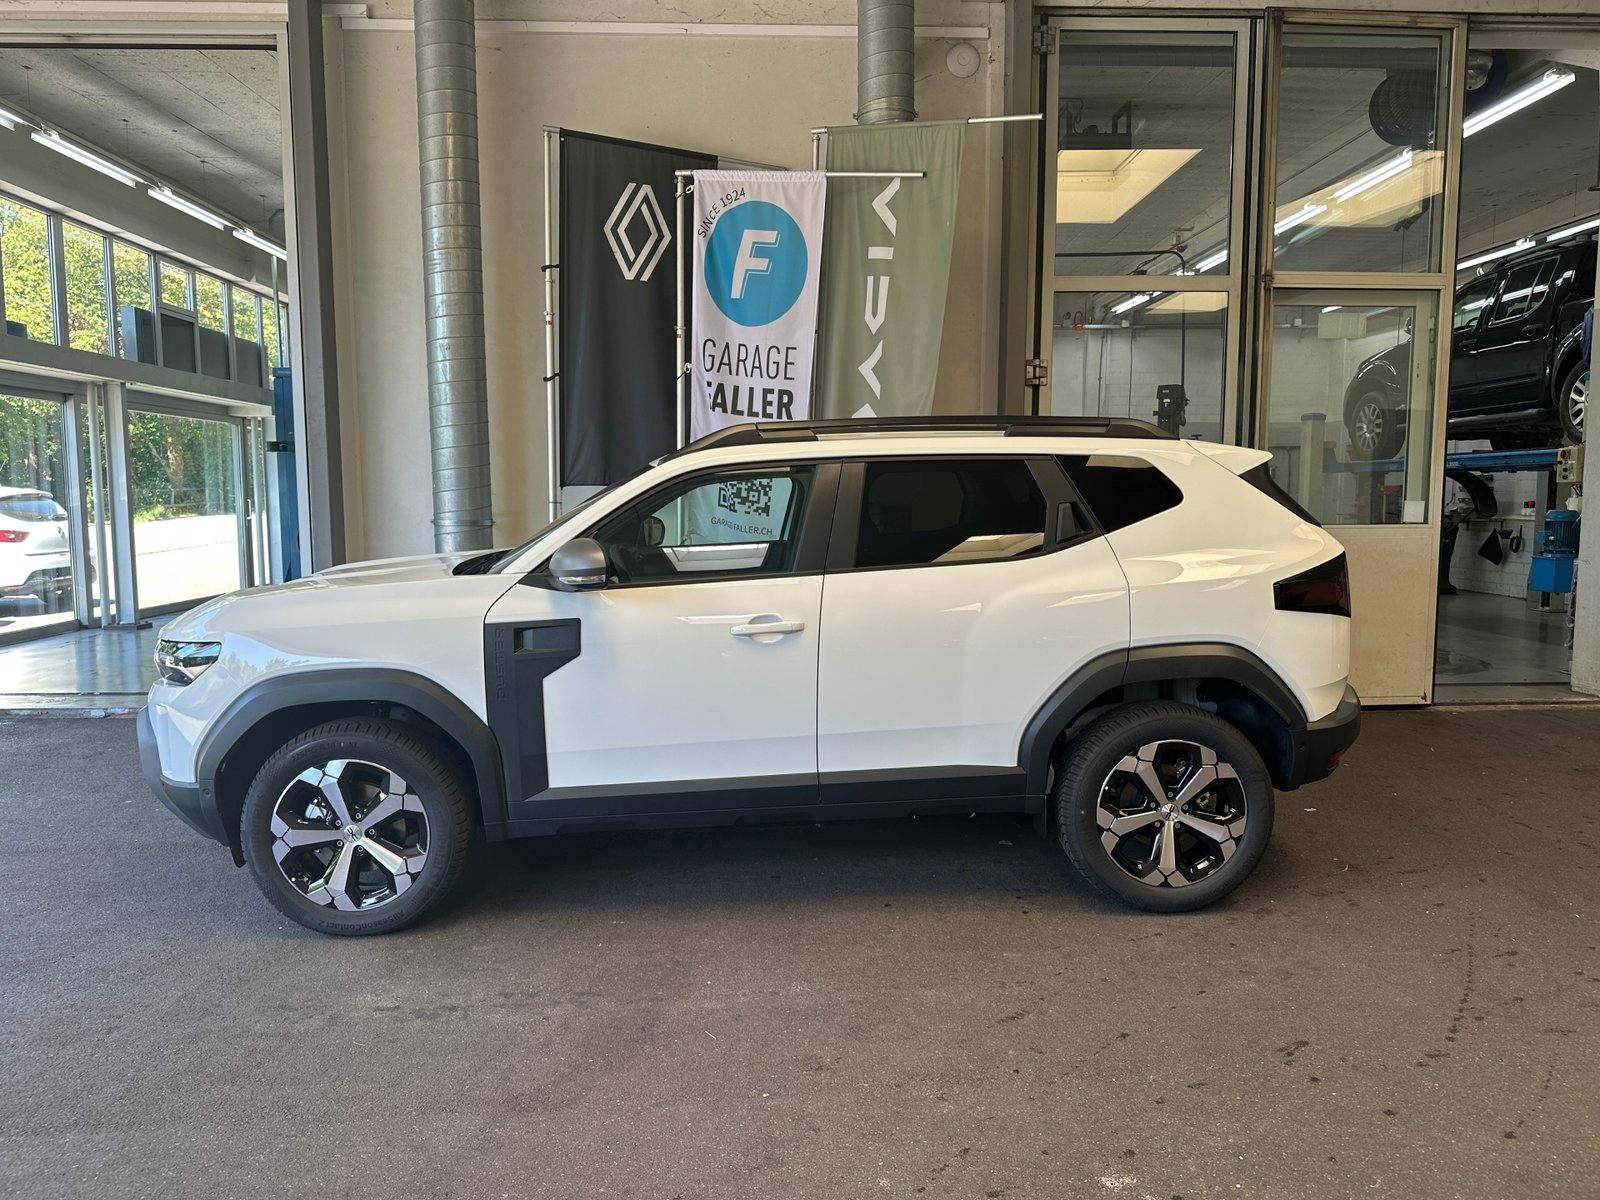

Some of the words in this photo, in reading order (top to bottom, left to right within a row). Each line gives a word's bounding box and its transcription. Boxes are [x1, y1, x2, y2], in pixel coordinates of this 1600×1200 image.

[697, 203, 720, 238] SINCE
[719, 187, 746, 208] 1924
[730, 229, 781, 299] F
[851, 176, 901, 418] ACIA
[702, 338, 798, 380] GARAGE
